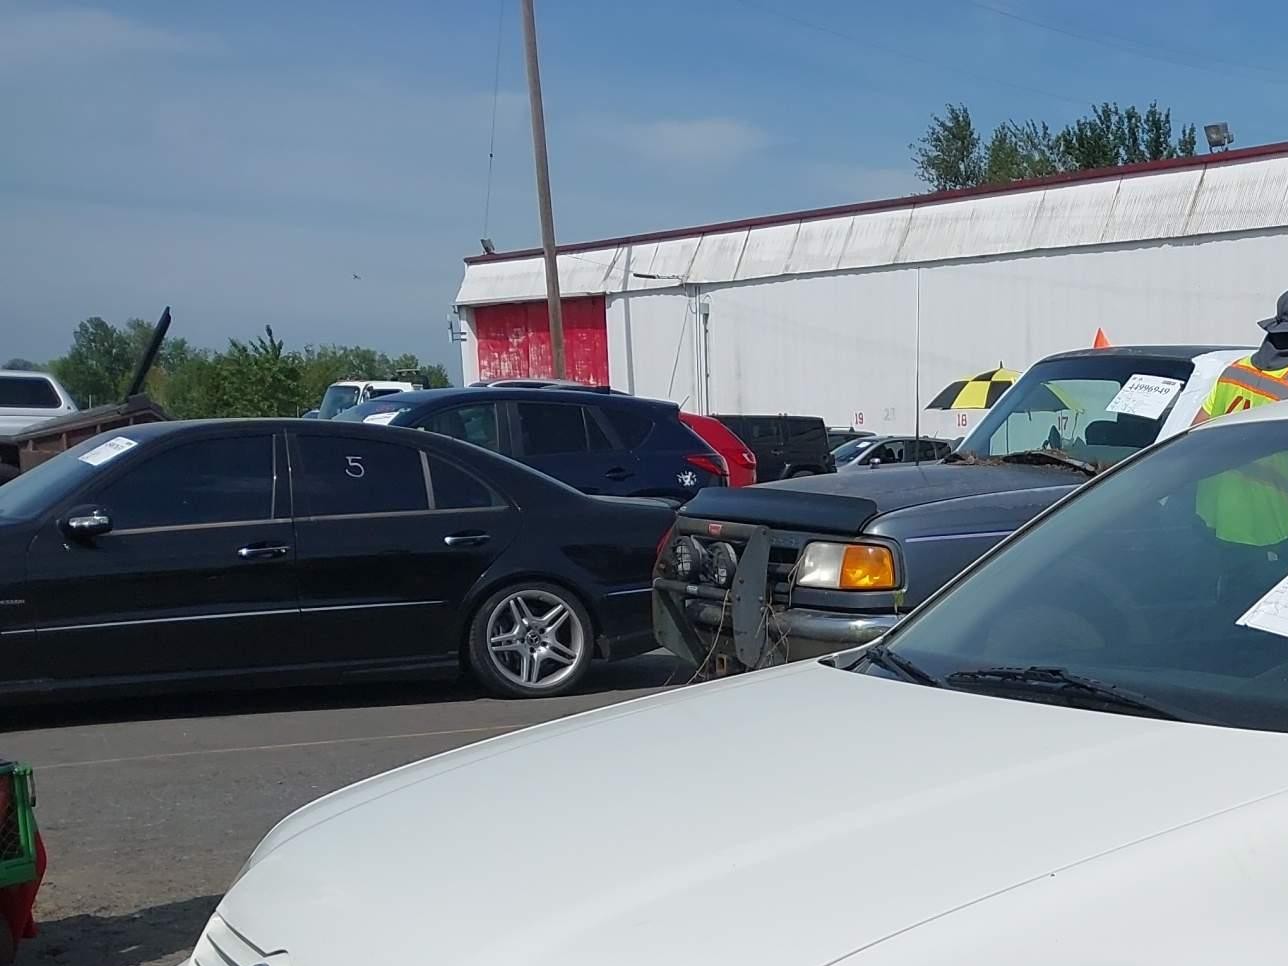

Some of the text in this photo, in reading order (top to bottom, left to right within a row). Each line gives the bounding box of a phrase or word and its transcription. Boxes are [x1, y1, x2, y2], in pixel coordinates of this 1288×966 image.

[855, 412, 864, 425] 19
[957, 413, 967, 427] 18
[1057, 415, 1069, 431] 17
[345, 455, 365, 478] 5
